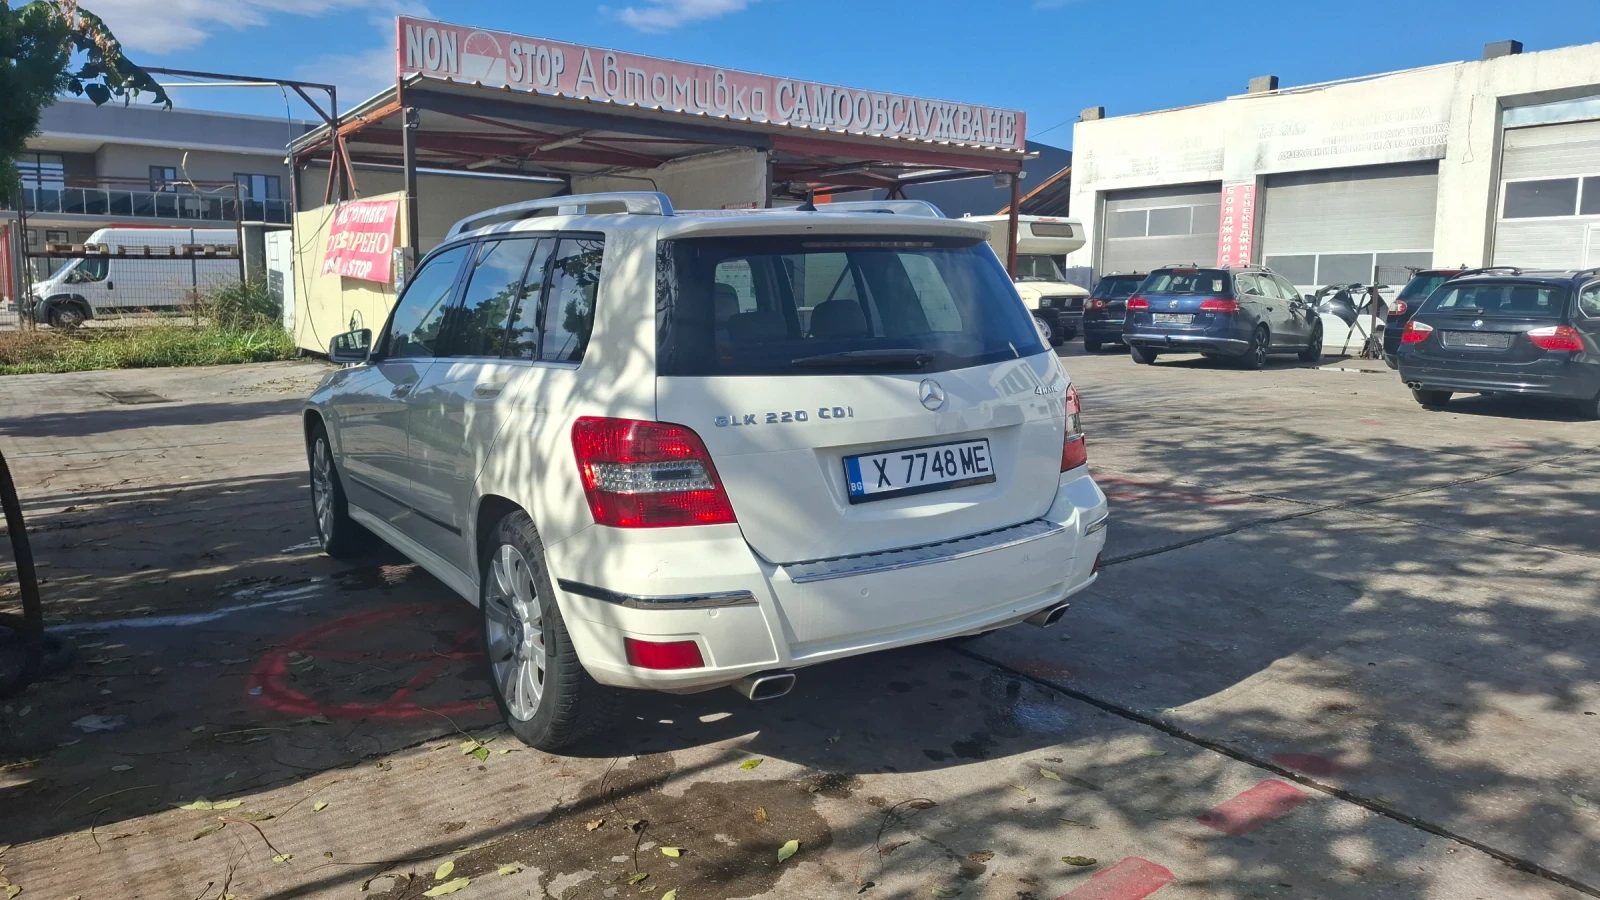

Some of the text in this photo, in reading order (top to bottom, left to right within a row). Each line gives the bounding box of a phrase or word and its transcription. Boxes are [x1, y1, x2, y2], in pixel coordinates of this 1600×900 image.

[405, 24, 1017, 145] NON STOP Автомивка САМООБСЛУЖВАНЕ
[1405, 121, 1449, 138] ТЕХНИКА
[1277, 133, 1448, 161] ДИЗЕЛОВИ И БЕНЗИНОВИ АВТОМОБИЛИ
[347, 259, 372, 278] STOP
[714, 405, 854, 428] GLK 220 CDI
[851, 481, 863, 492] BG
